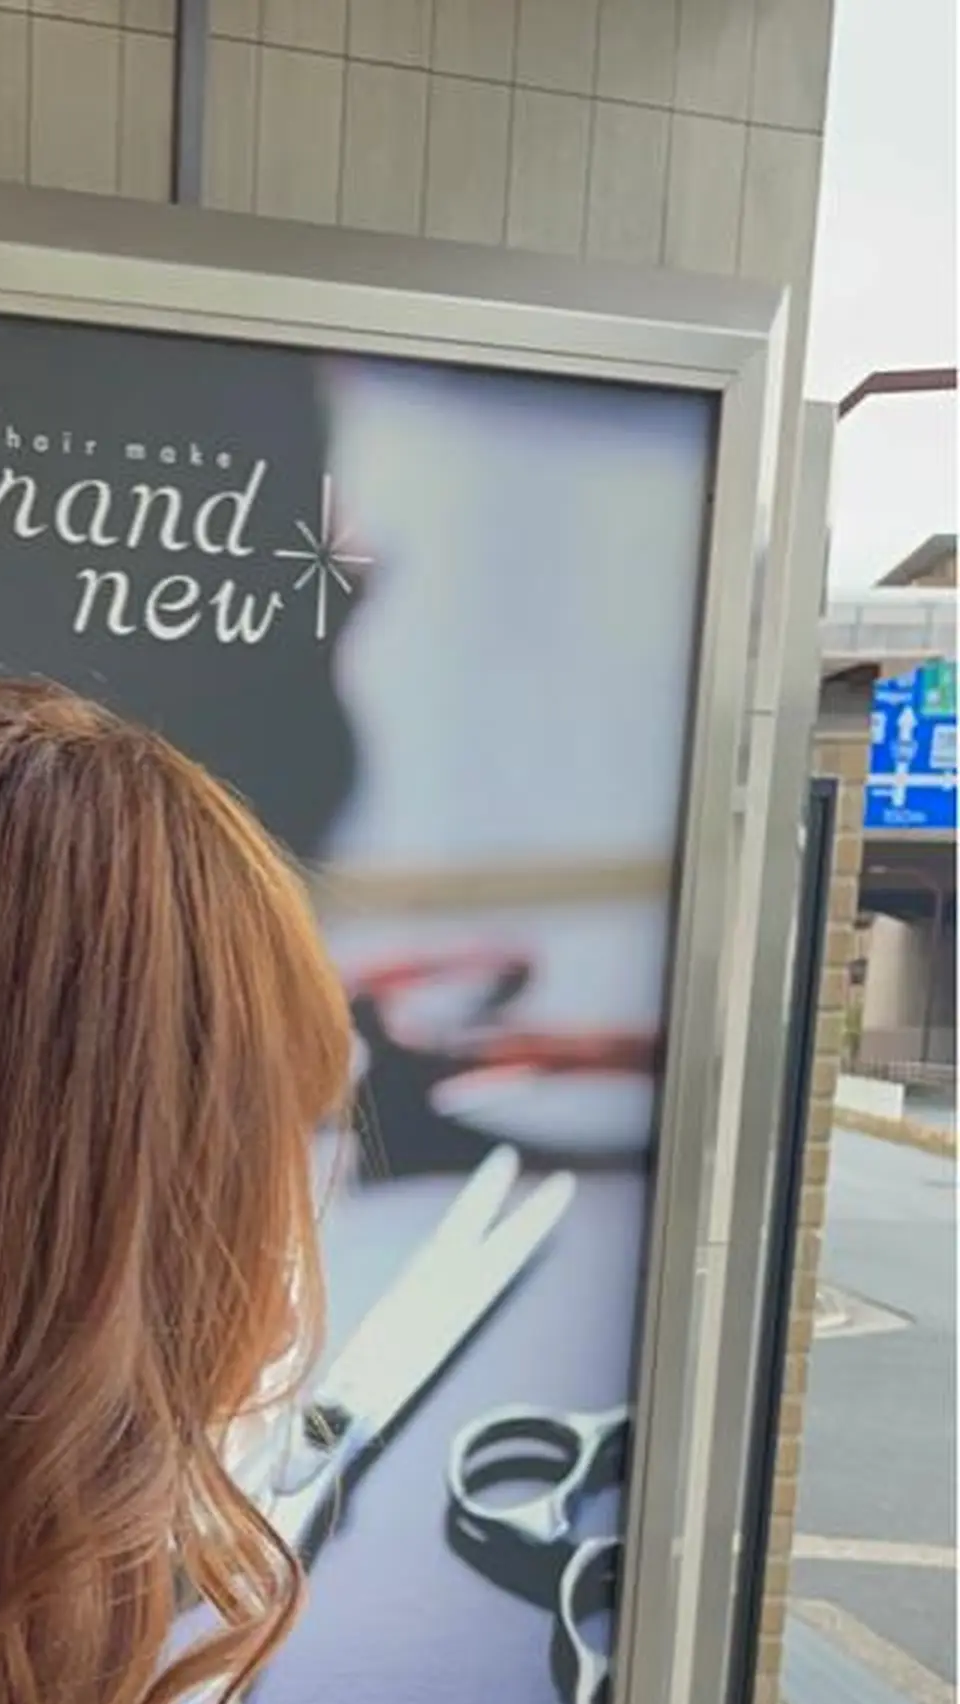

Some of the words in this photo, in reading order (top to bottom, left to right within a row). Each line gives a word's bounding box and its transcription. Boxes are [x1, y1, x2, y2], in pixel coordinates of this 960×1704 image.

[6, 426, 98, 453] hair
[125, 442, 232, 469] make
[73, 567, 284, 644] new
